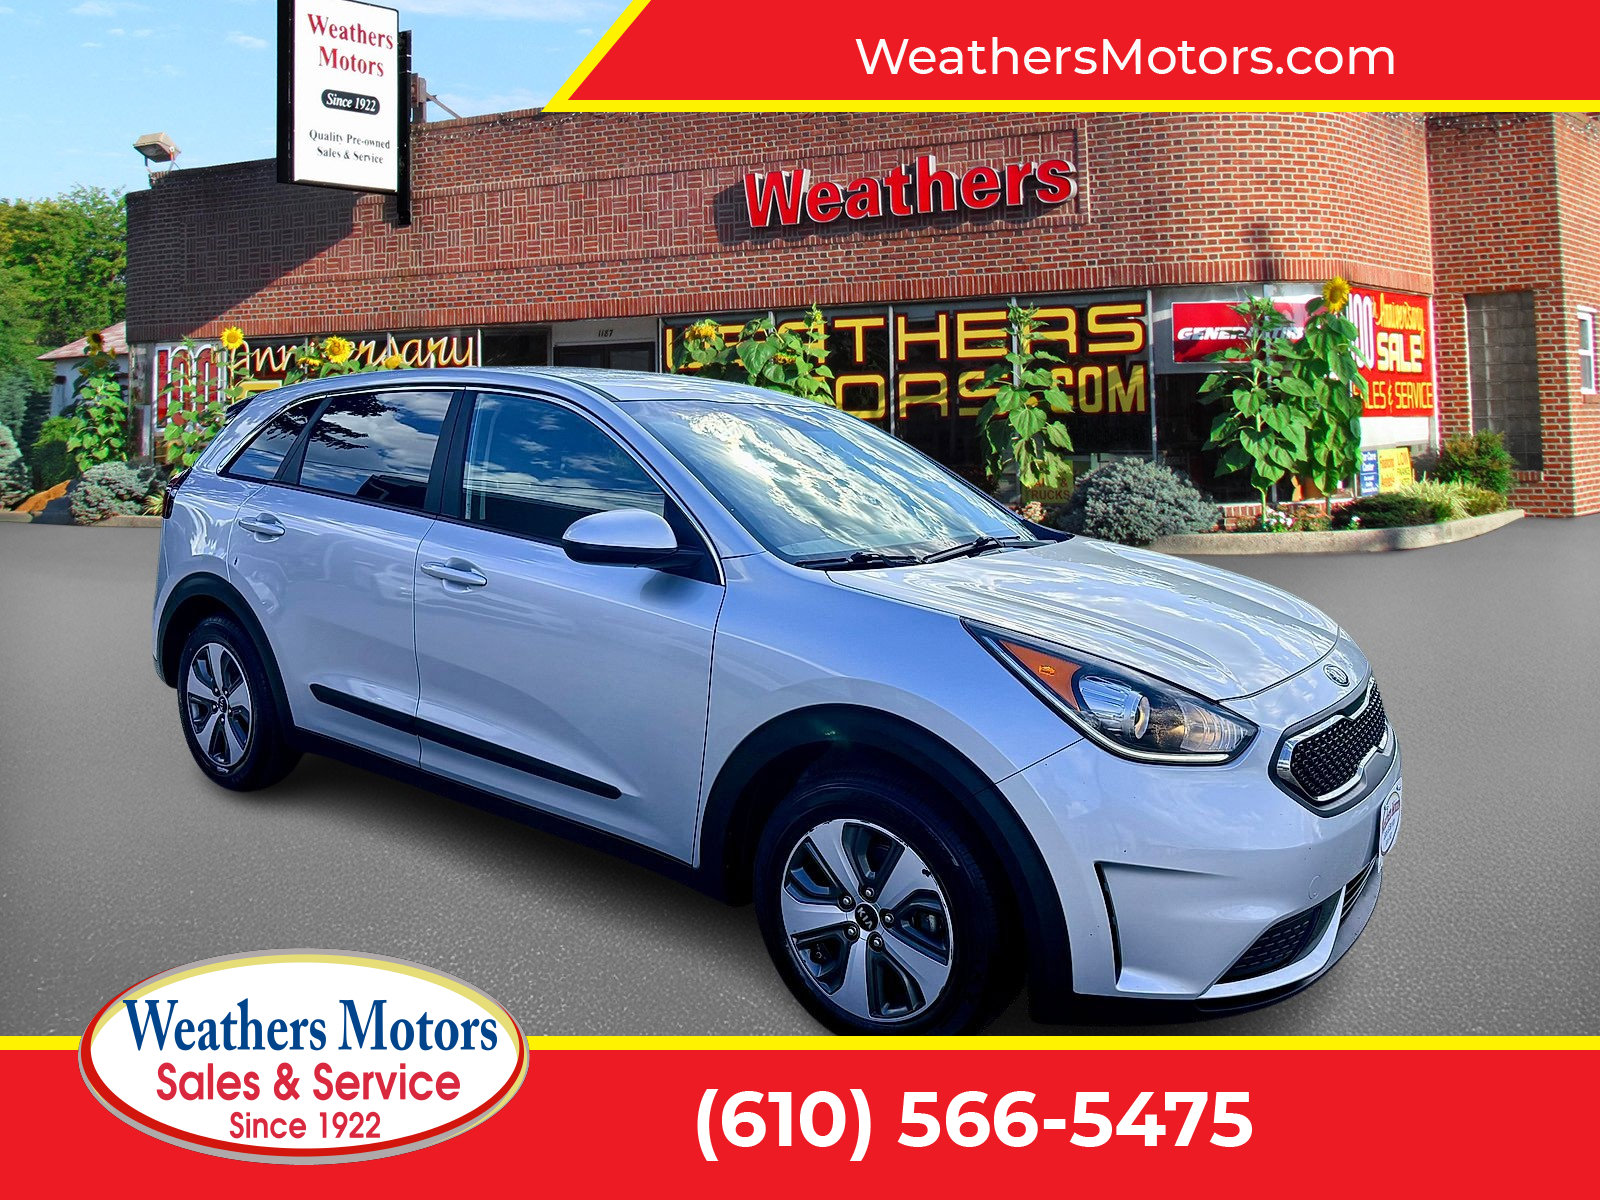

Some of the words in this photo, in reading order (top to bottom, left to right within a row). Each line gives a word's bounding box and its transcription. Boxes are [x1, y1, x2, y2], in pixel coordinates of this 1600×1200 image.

[307, 13, 394, 50] Weathers
[318, 45, 385, 78] Motors
[326, 92, 353, 109] Since
[354, 97, 377, 113] 1922
[308, 128, 344, 145] Quality
[346, 133, 391, 150] Pre-owned
[316, 146, 342, 159] Sales
[343, 151, 351, 160] &
[353, 151, 384, 164] Service
[743, 154, 1078, 228] Weathers
[597, 329, 614, 338] 1187
[1376, 331, 1423, 373] SALE
[1395, 381, 1434, 409] SERVICE
[1029, 489, 1071, 500] RUCKS
